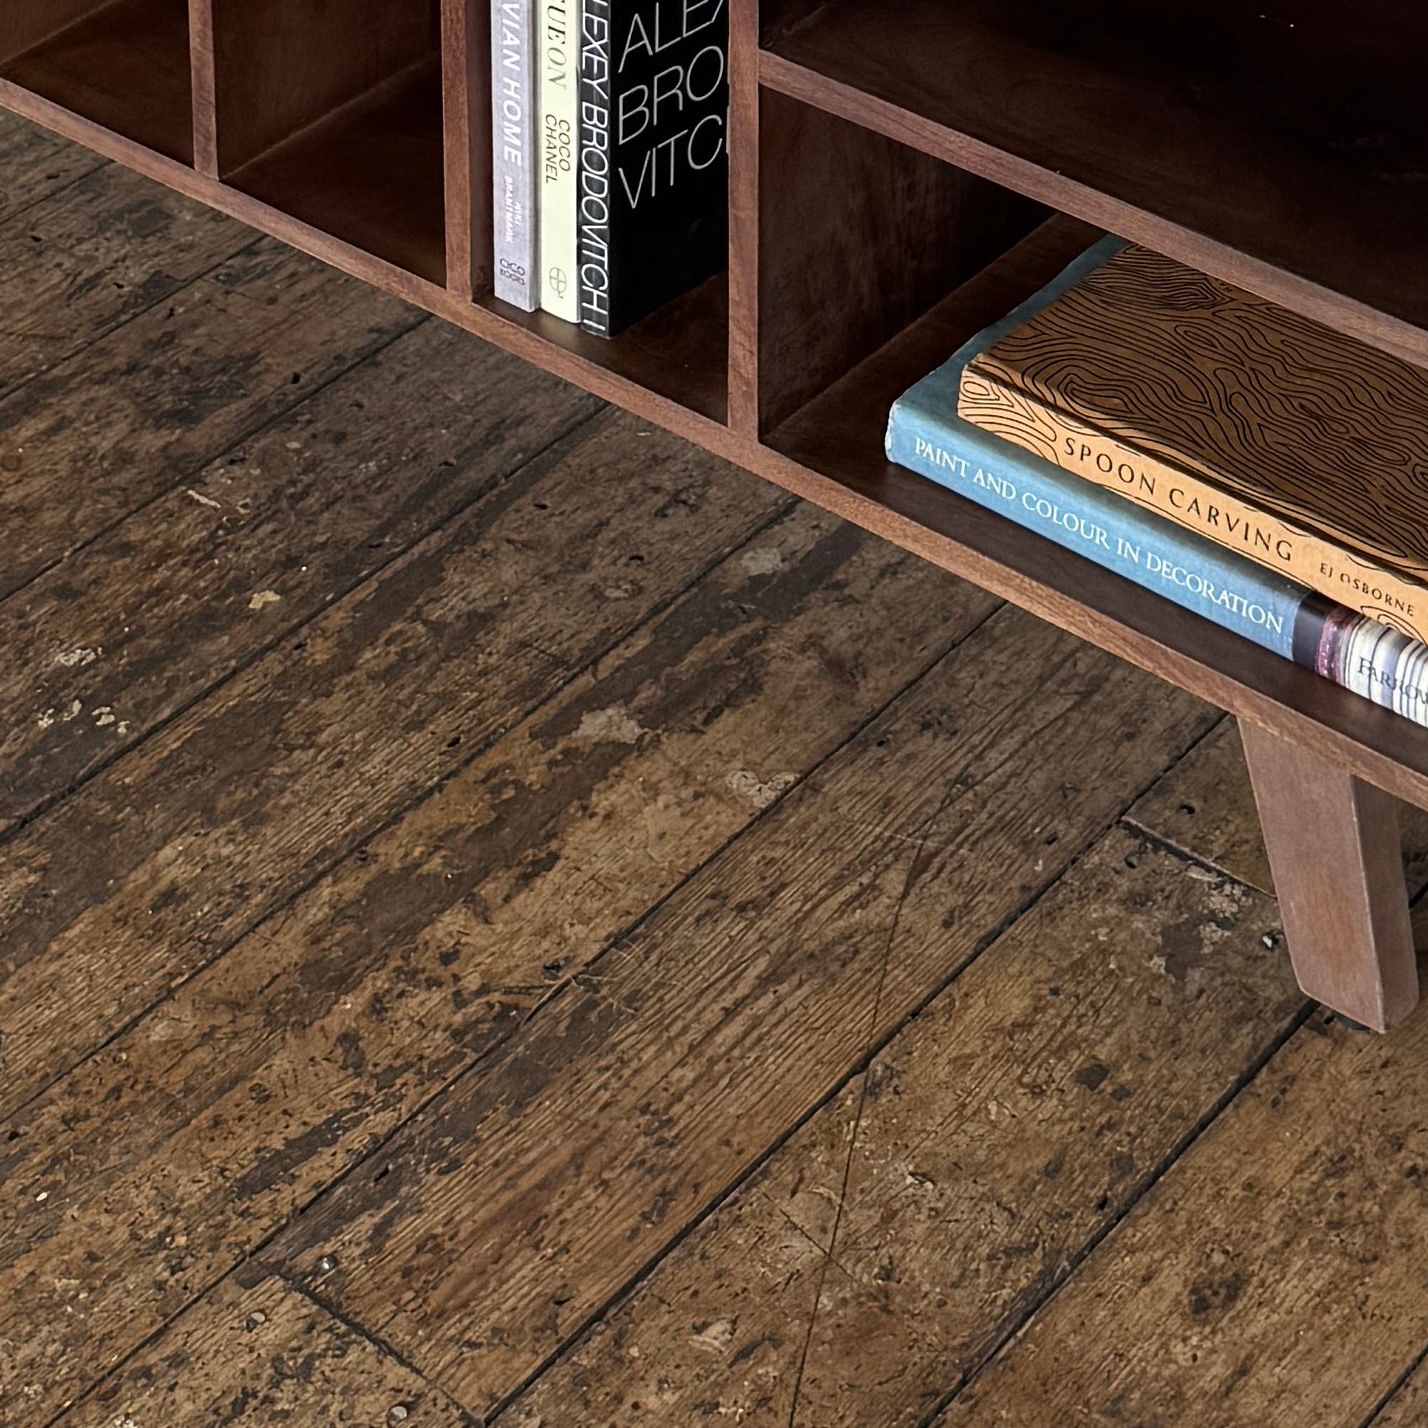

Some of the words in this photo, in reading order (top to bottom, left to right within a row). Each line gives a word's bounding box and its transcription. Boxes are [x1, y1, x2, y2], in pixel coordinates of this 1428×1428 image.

[546, 46, 568, 92] ON
[618, 45, 729, 146] BRO
[502, 76, 523, 167] HOME
[545, 113, 559, 184] CHANEL
[558, 119, 572, 173] COCO
[618, 104, 729, 210] VITC
[581, 101, 609, 316] BRODOVITCH
[914, 437, 970, 478] PAINT
[973, 468, 1017, 501] AND
[1021, 491, 1111, 551] COLOUR
[1116, 537, 1141, 564] IN
[1145, 553, 1285, 635] DECORATION
[1064, 436, 1156, 496] SPOON
[1168, 487, 1294, 562] CARVING
[1319, 562, 1334, 578] EJ
[1339, 572, 1416, 618] OSBORNE
